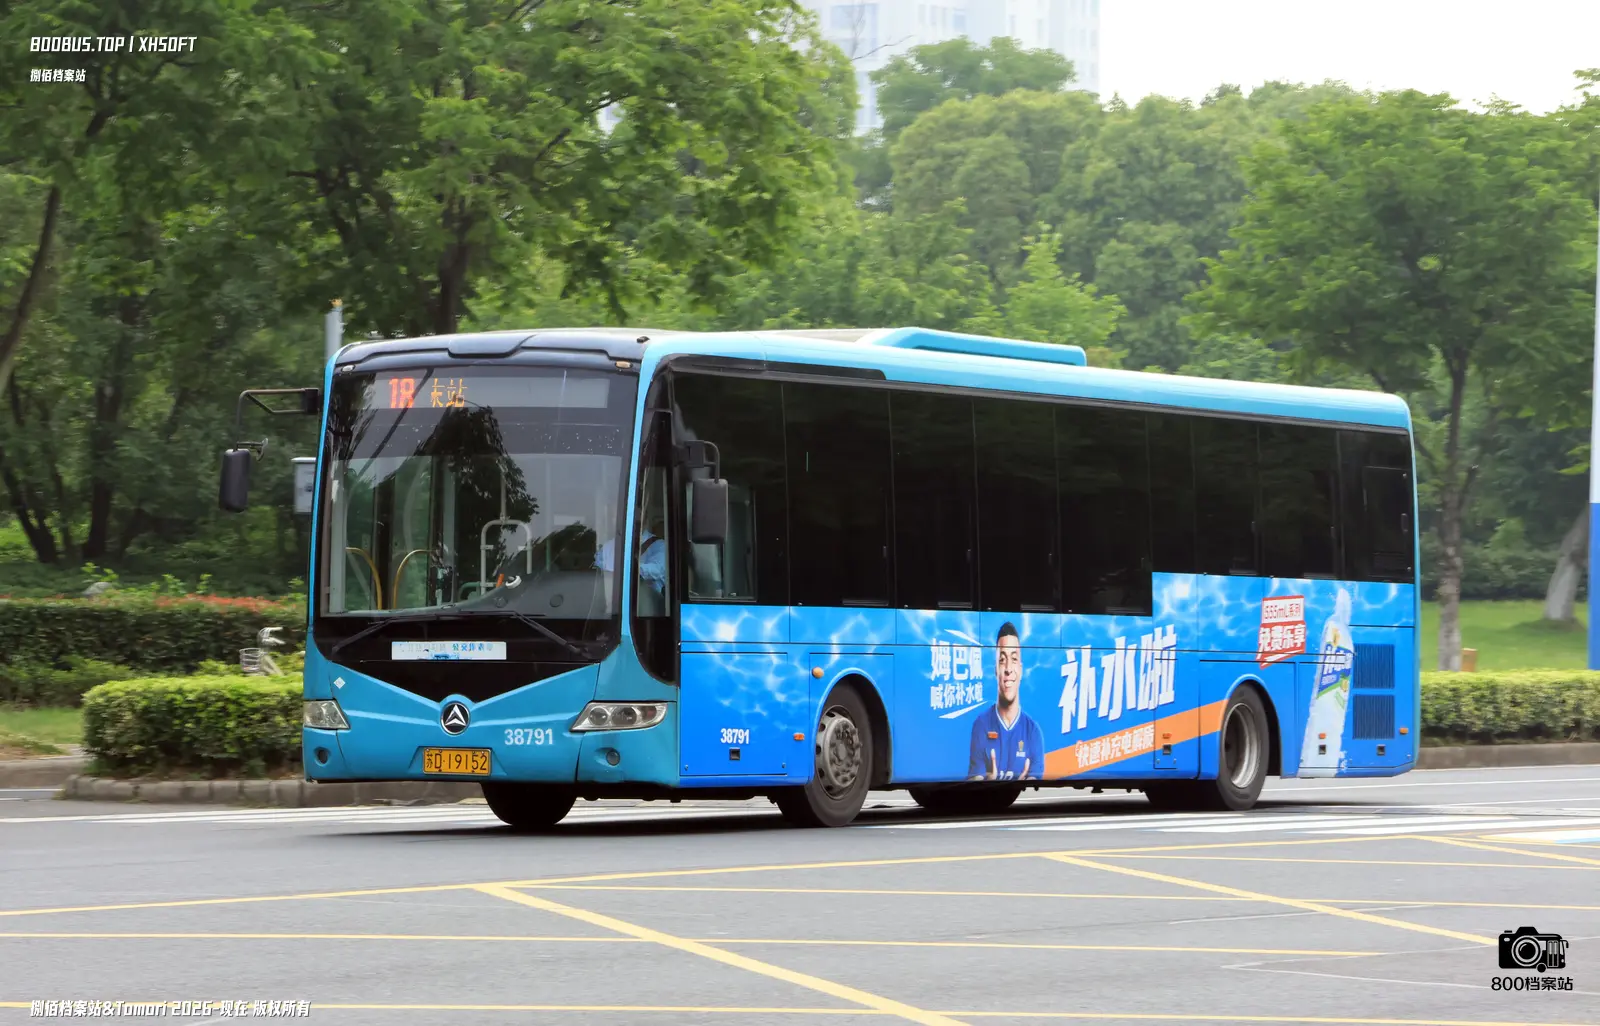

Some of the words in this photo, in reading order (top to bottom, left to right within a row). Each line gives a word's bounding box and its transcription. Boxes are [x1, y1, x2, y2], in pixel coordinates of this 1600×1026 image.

[1058, 624, 1177, 734] 补水啦
[504, 728, 553, 745] 38791
[720, 728, 750, 744] 38791
[1077, 724, 1154, 769] 快速补充电解质
